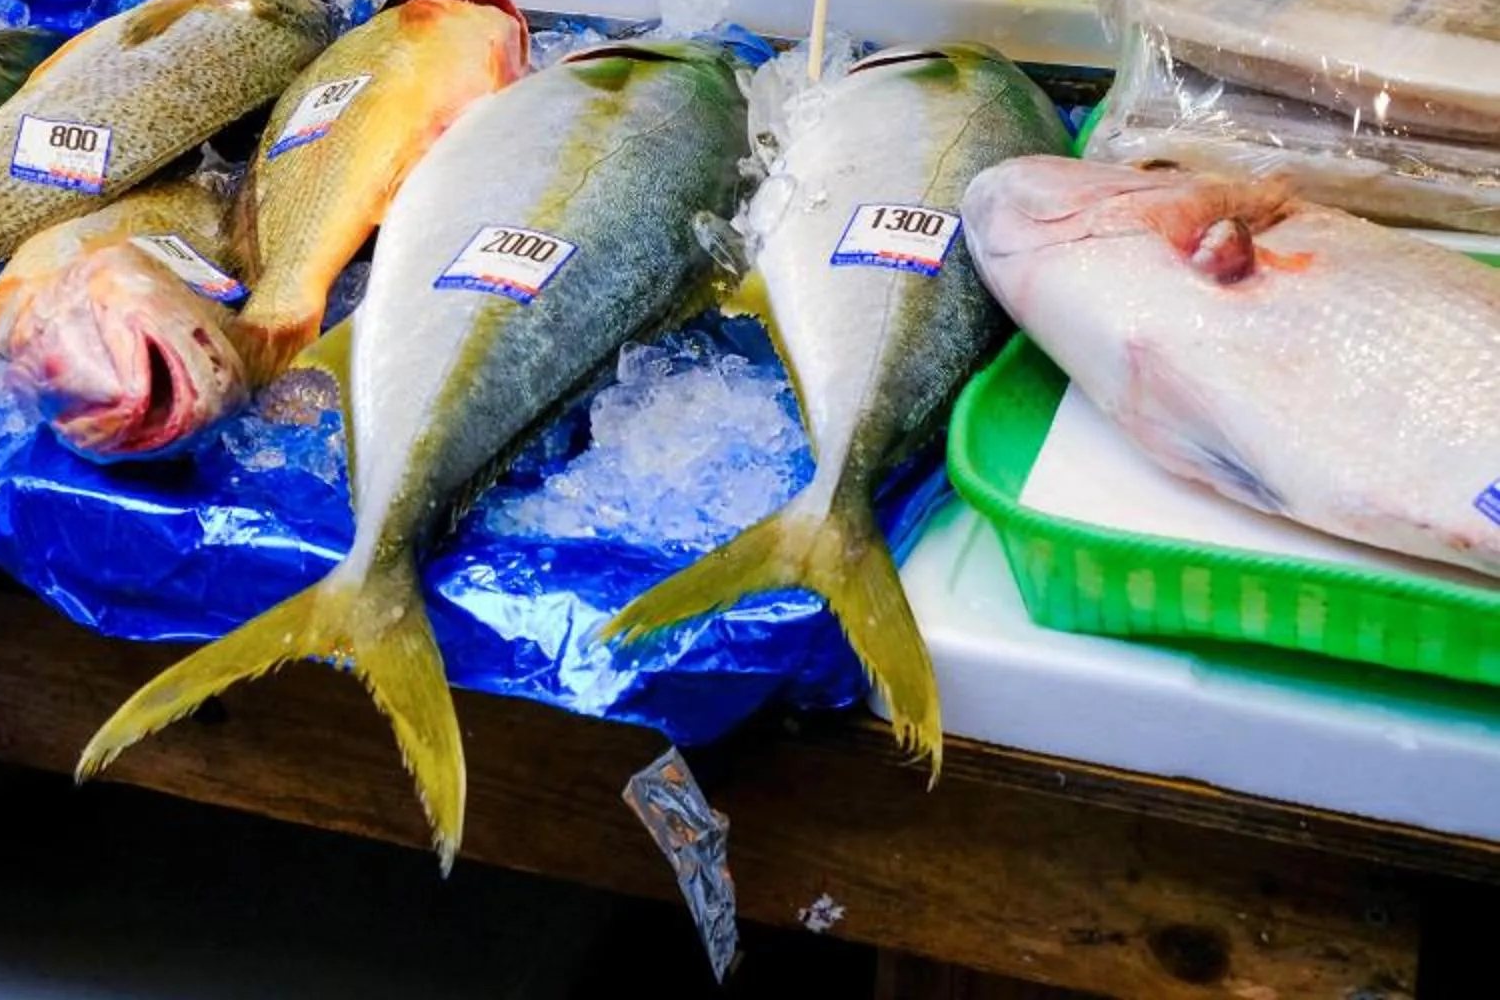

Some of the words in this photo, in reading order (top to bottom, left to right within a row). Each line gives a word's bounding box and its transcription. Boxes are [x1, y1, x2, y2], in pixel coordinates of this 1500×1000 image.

[49, 125, 98, 153] 800
[870, 207, 945, 237] 1300
[481, 229, 559, 263] 2000
